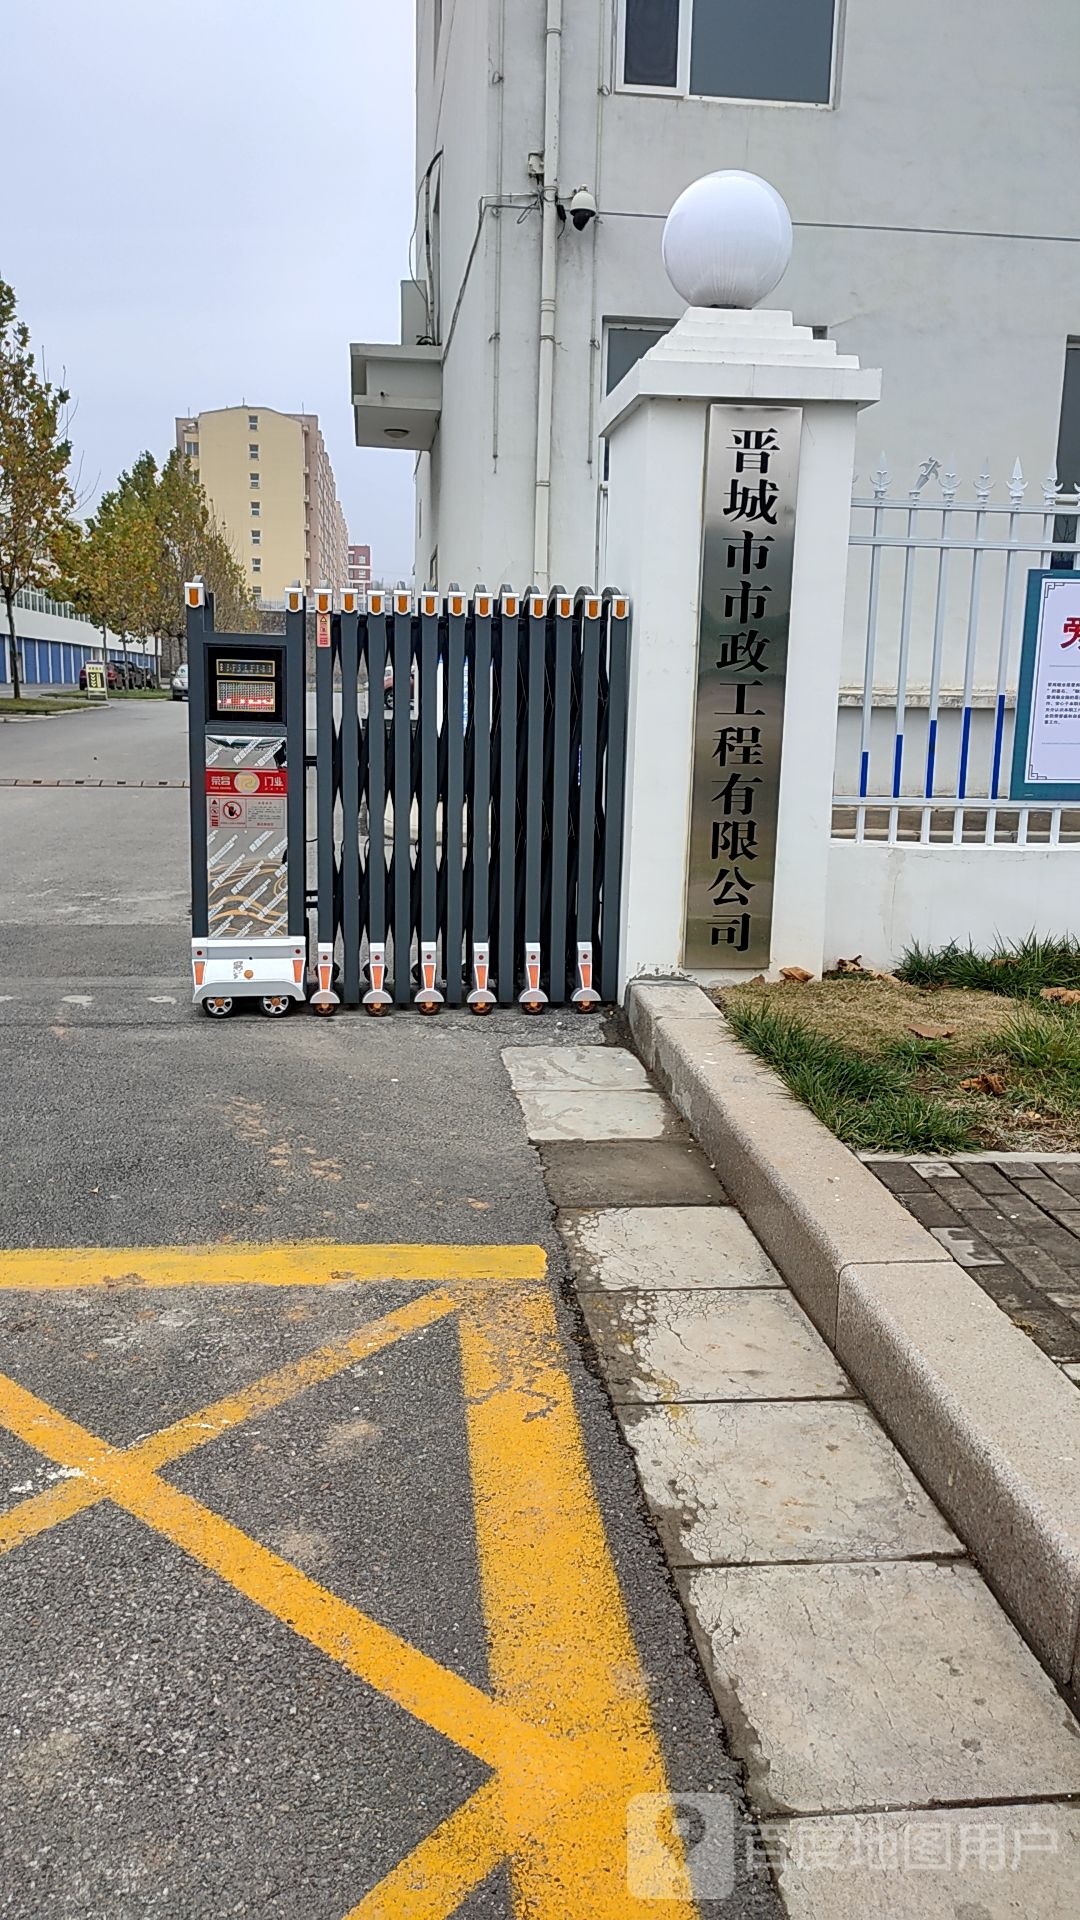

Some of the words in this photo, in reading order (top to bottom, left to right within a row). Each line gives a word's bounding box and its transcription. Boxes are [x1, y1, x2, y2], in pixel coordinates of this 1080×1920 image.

[264, 776, 284, 787] 门业
[707, 428, 781, 952] 晋城市市政工程有限公司
